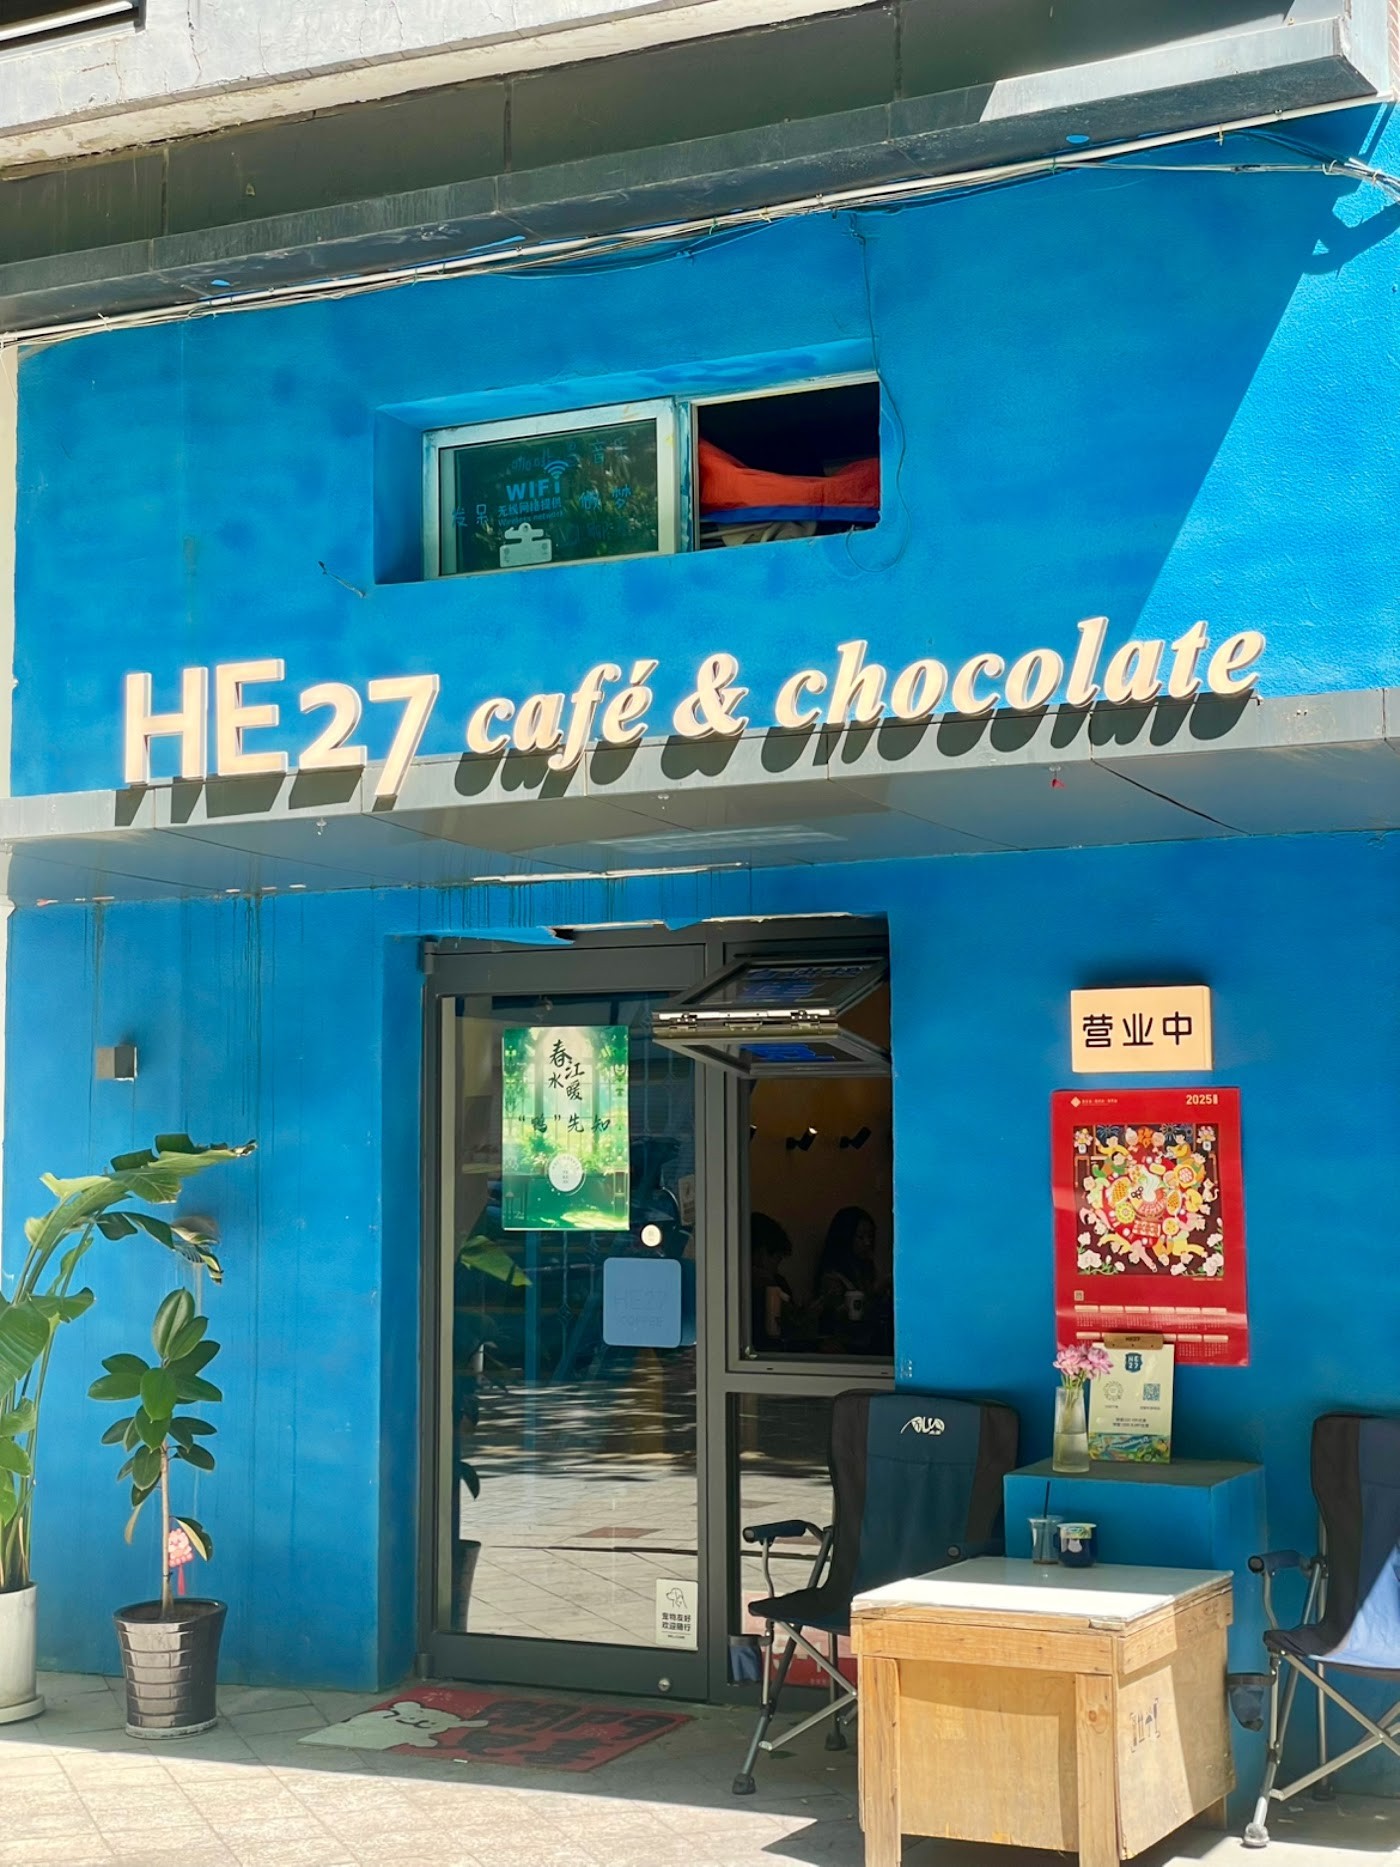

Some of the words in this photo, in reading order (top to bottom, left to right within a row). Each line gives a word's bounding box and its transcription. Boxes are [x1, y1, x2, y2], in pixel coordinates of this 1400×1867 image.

[124, 658, 439, 798] HE27
[466, 660, 660, 772] café
[672, 652, 750, 738] &
[775, 616, 1266, 729] chocolate
[1082, 1011, 1193, 1048] 营业中
